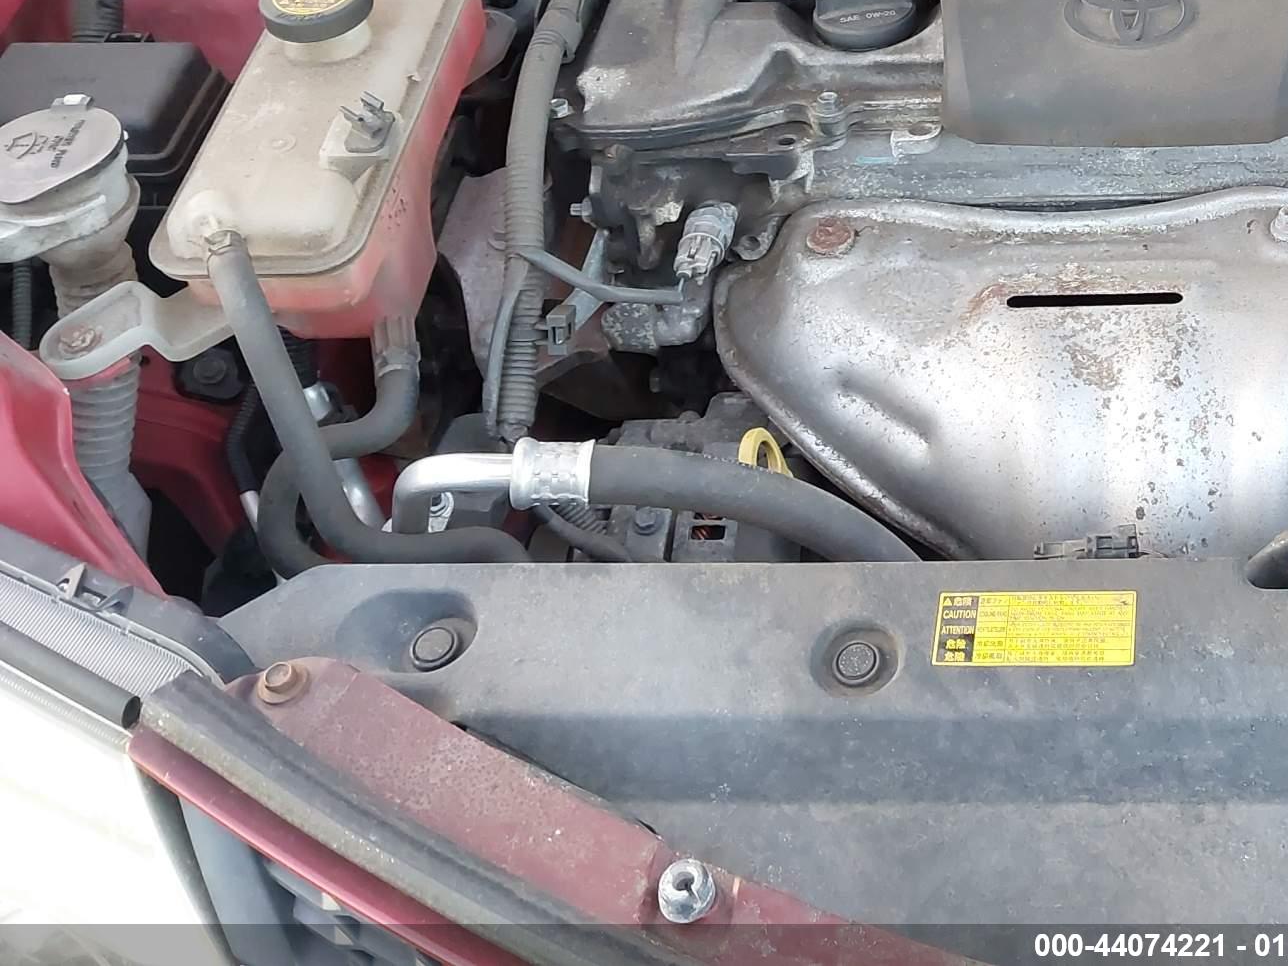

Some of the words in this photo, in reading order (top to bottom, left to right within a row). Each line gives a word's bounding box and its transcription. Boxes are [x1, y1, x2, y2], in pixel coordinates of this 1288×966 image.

[840, 15, 861, 24] SAE
[943, 610, 977, 619] CAUTION
[941, 626, 975, 635] ATTENTION
